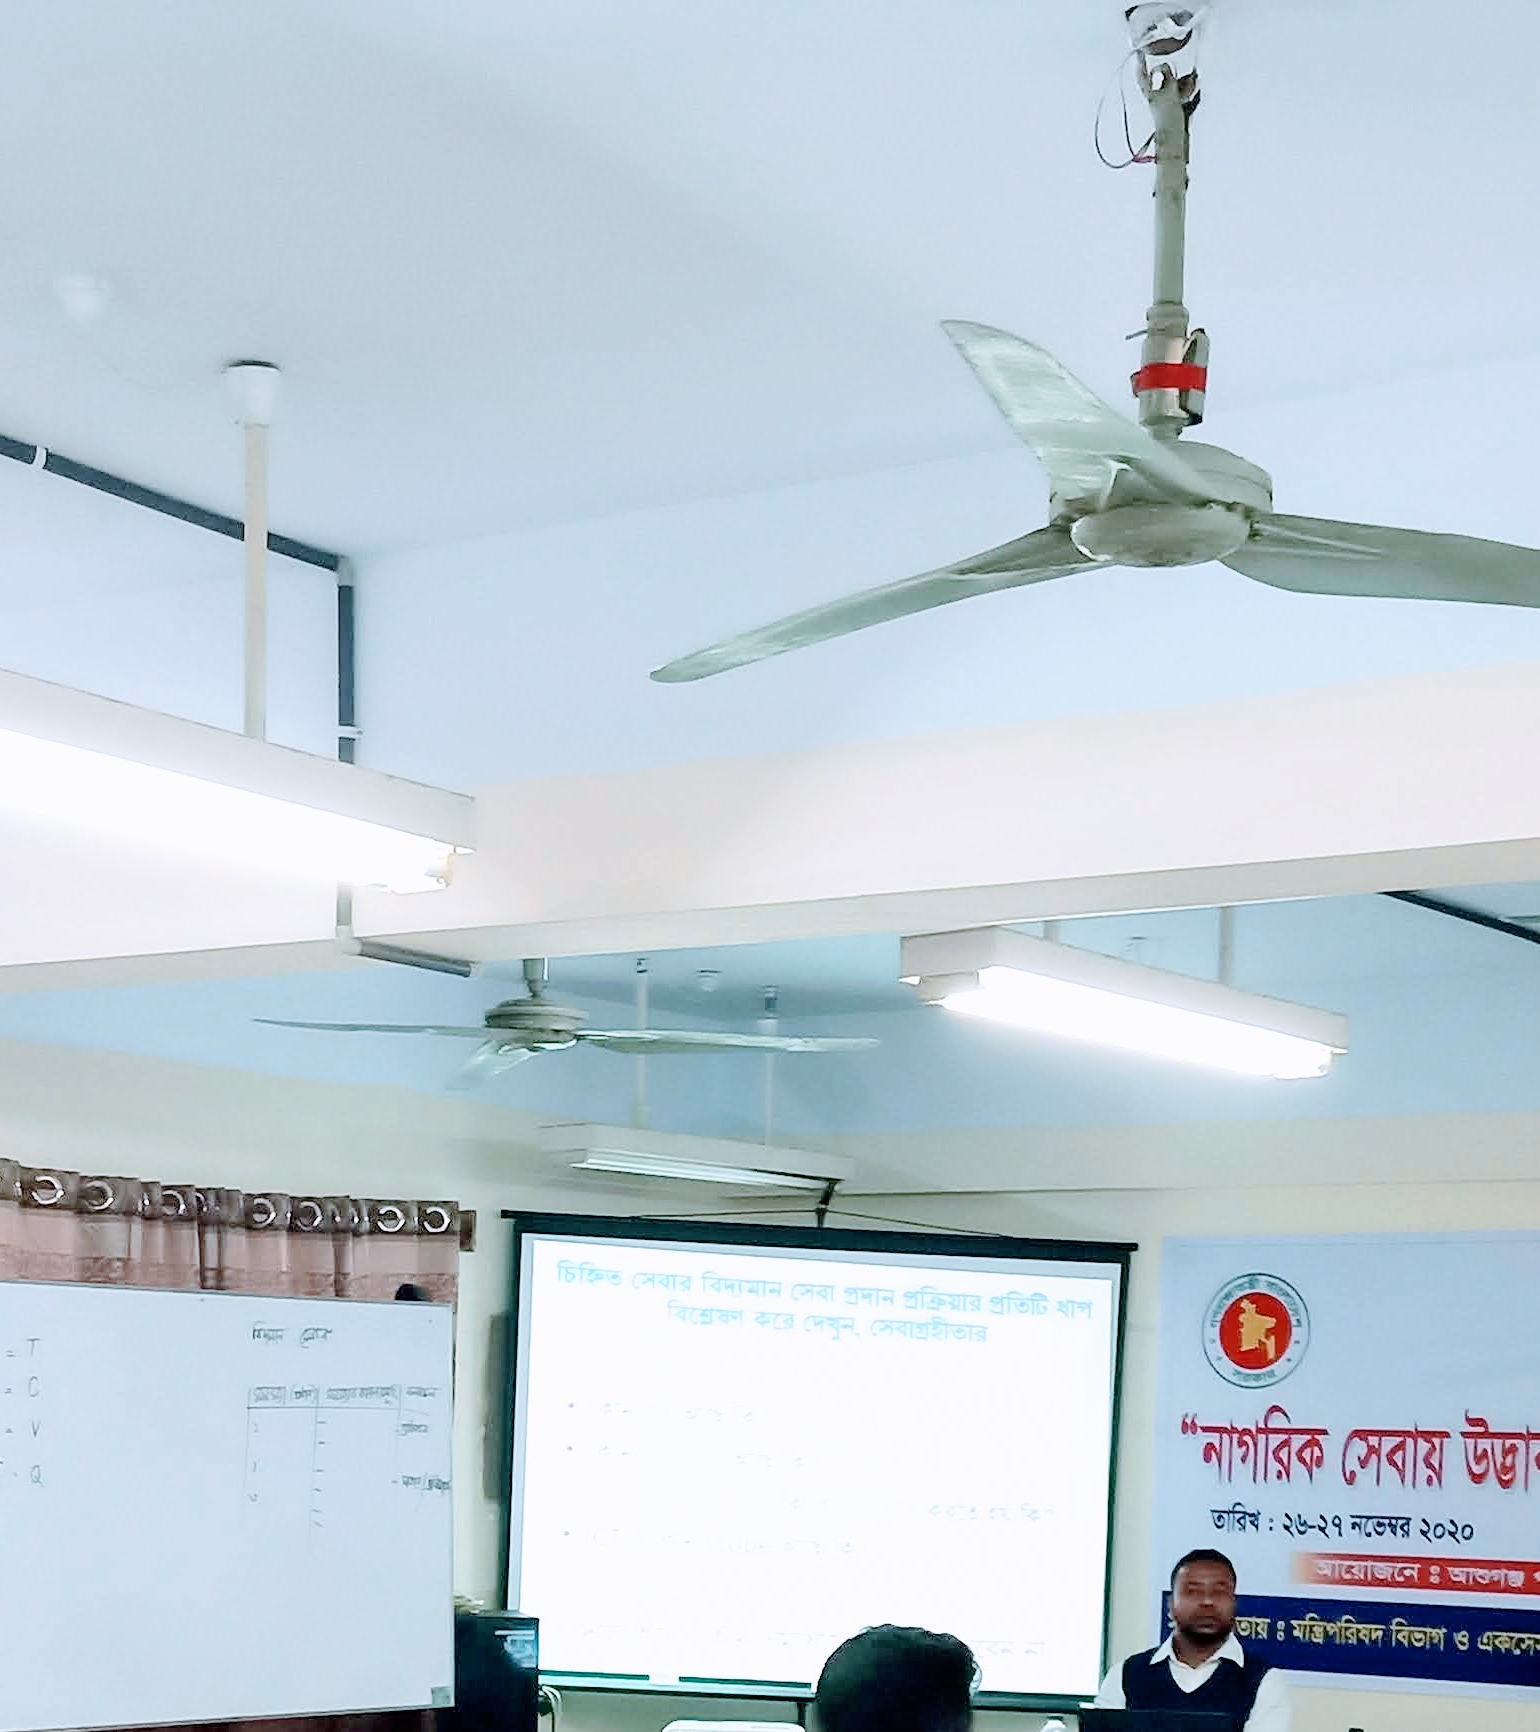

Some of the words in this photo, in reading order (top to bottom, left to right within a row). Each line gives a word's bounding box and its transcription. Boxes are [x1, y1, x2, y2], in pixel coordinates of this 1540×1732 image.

[633, 1272, 692, 1295] সেবার
[791, 1282, 835, 1303] সেবা
[844, 1287, 895, 1309] প্রদান
[988, 1288, 1049, 1316] প্রতিটি
[1056, 1297, 1094, 1319] ধাপ
[754, 1311, 795, 1329] করে
[26, 1338, 41, 1357] T
[28, 1376, 40, 1397] C
[31, 1421, 41, 1438] V
[1181, 1405, 1328, 1484] “নাগরিক
[1341, 1424, 1450, 1489] সেবায়
[30, 1465, 44, 1488] Q
[1210, 1502, 1261, 1533] তারিখ
[1282, 1513, 1342, 1538] ২৬-২৭
[1350, 1514, 1412, 1538] নভেম্বর
[1419, 1518, 1474, 1543] ২০২০
[1316, 1560, 1420, 1582] আয়োজনে
[1291, 1613, 1386, 1646] মন্ত্রিপরিষদ
[1390, 1618, 1446, 1650] বিভাগ
[1453, 1630, 1469, 1650] ও
